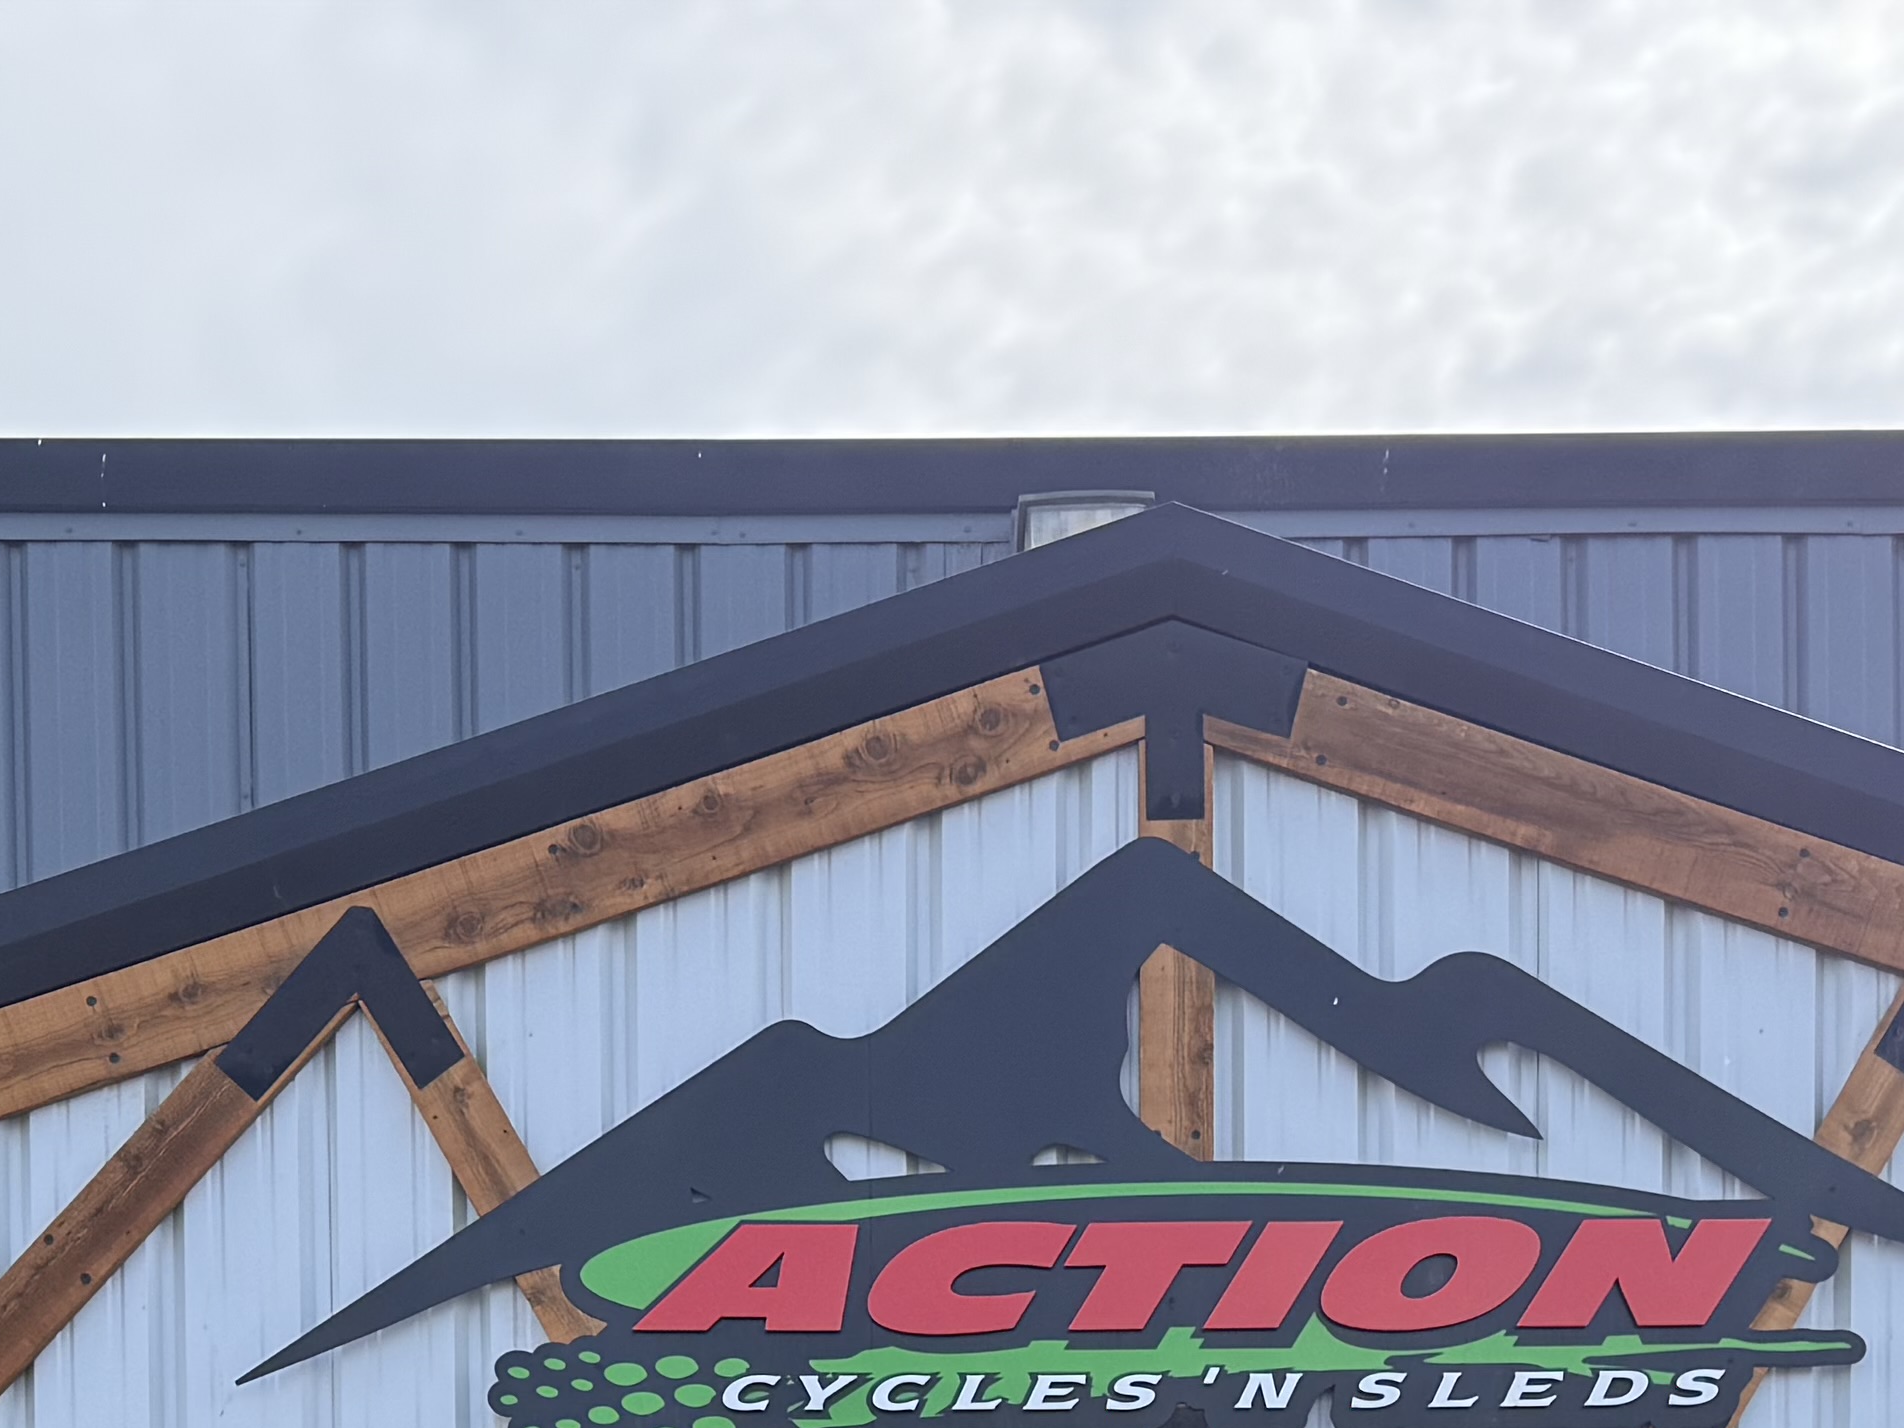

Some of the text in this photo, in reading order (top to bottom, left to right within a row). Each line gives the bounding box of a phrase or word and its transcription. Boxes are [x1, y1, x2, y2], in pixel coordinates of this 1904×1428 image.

[633, 1217, 1773, 1334] ACTION
[718, 1374, 1160, 1413] CYCLES
[1350, 1369, 1727, 1409] SLEDS
